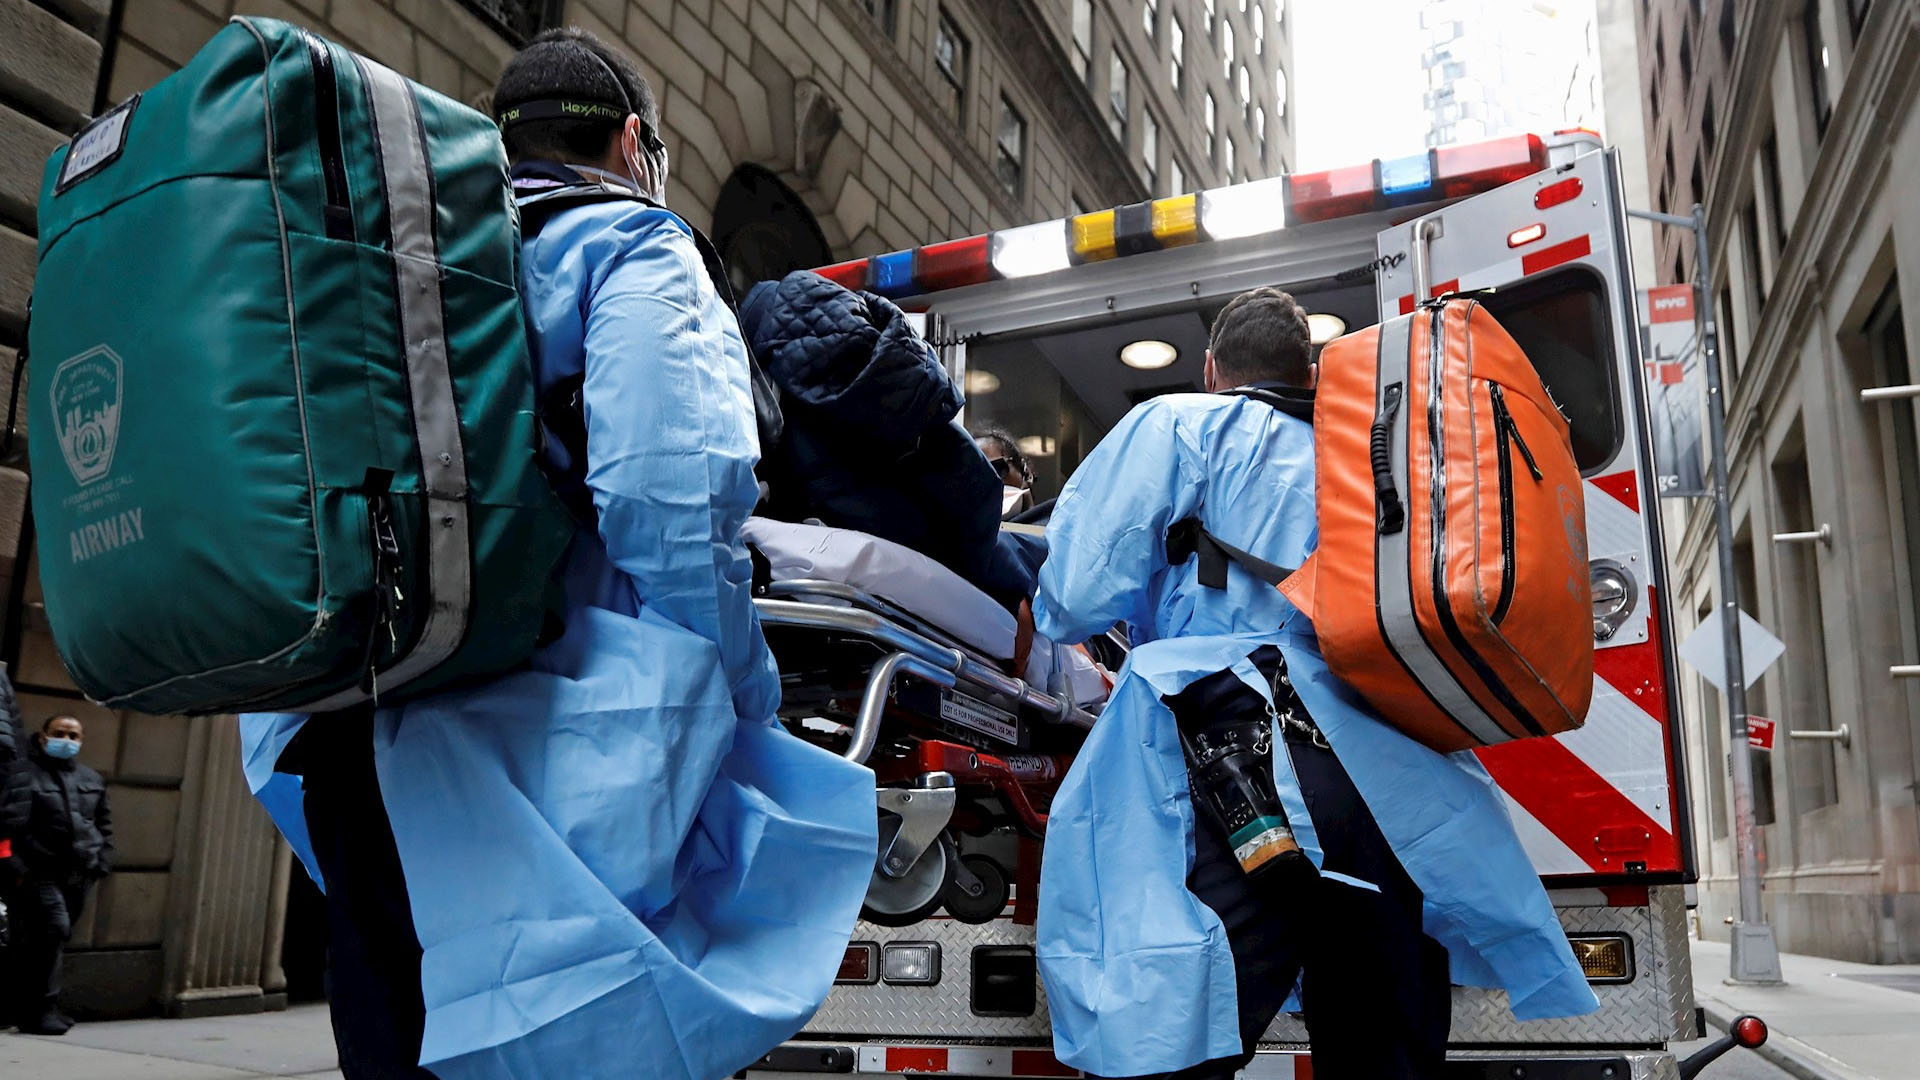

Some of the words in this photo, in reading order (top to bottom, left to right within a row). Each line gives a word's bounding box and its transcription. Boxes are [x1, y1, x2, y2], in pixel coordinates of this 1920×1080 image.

[561, 101, 621, 119] HexArmor
[1655, 296, 1687, 310] NYC
[115, 473, 135, 488] CALL
[69, 507, 144, 565] AIRWAY
[958, 709, 967, 719] FOR
[967, 713, 997, 732] PROFESSIONAL
[997, 725, 1005, 735] USE
[1005, 728, 1015, 738] ONLY
